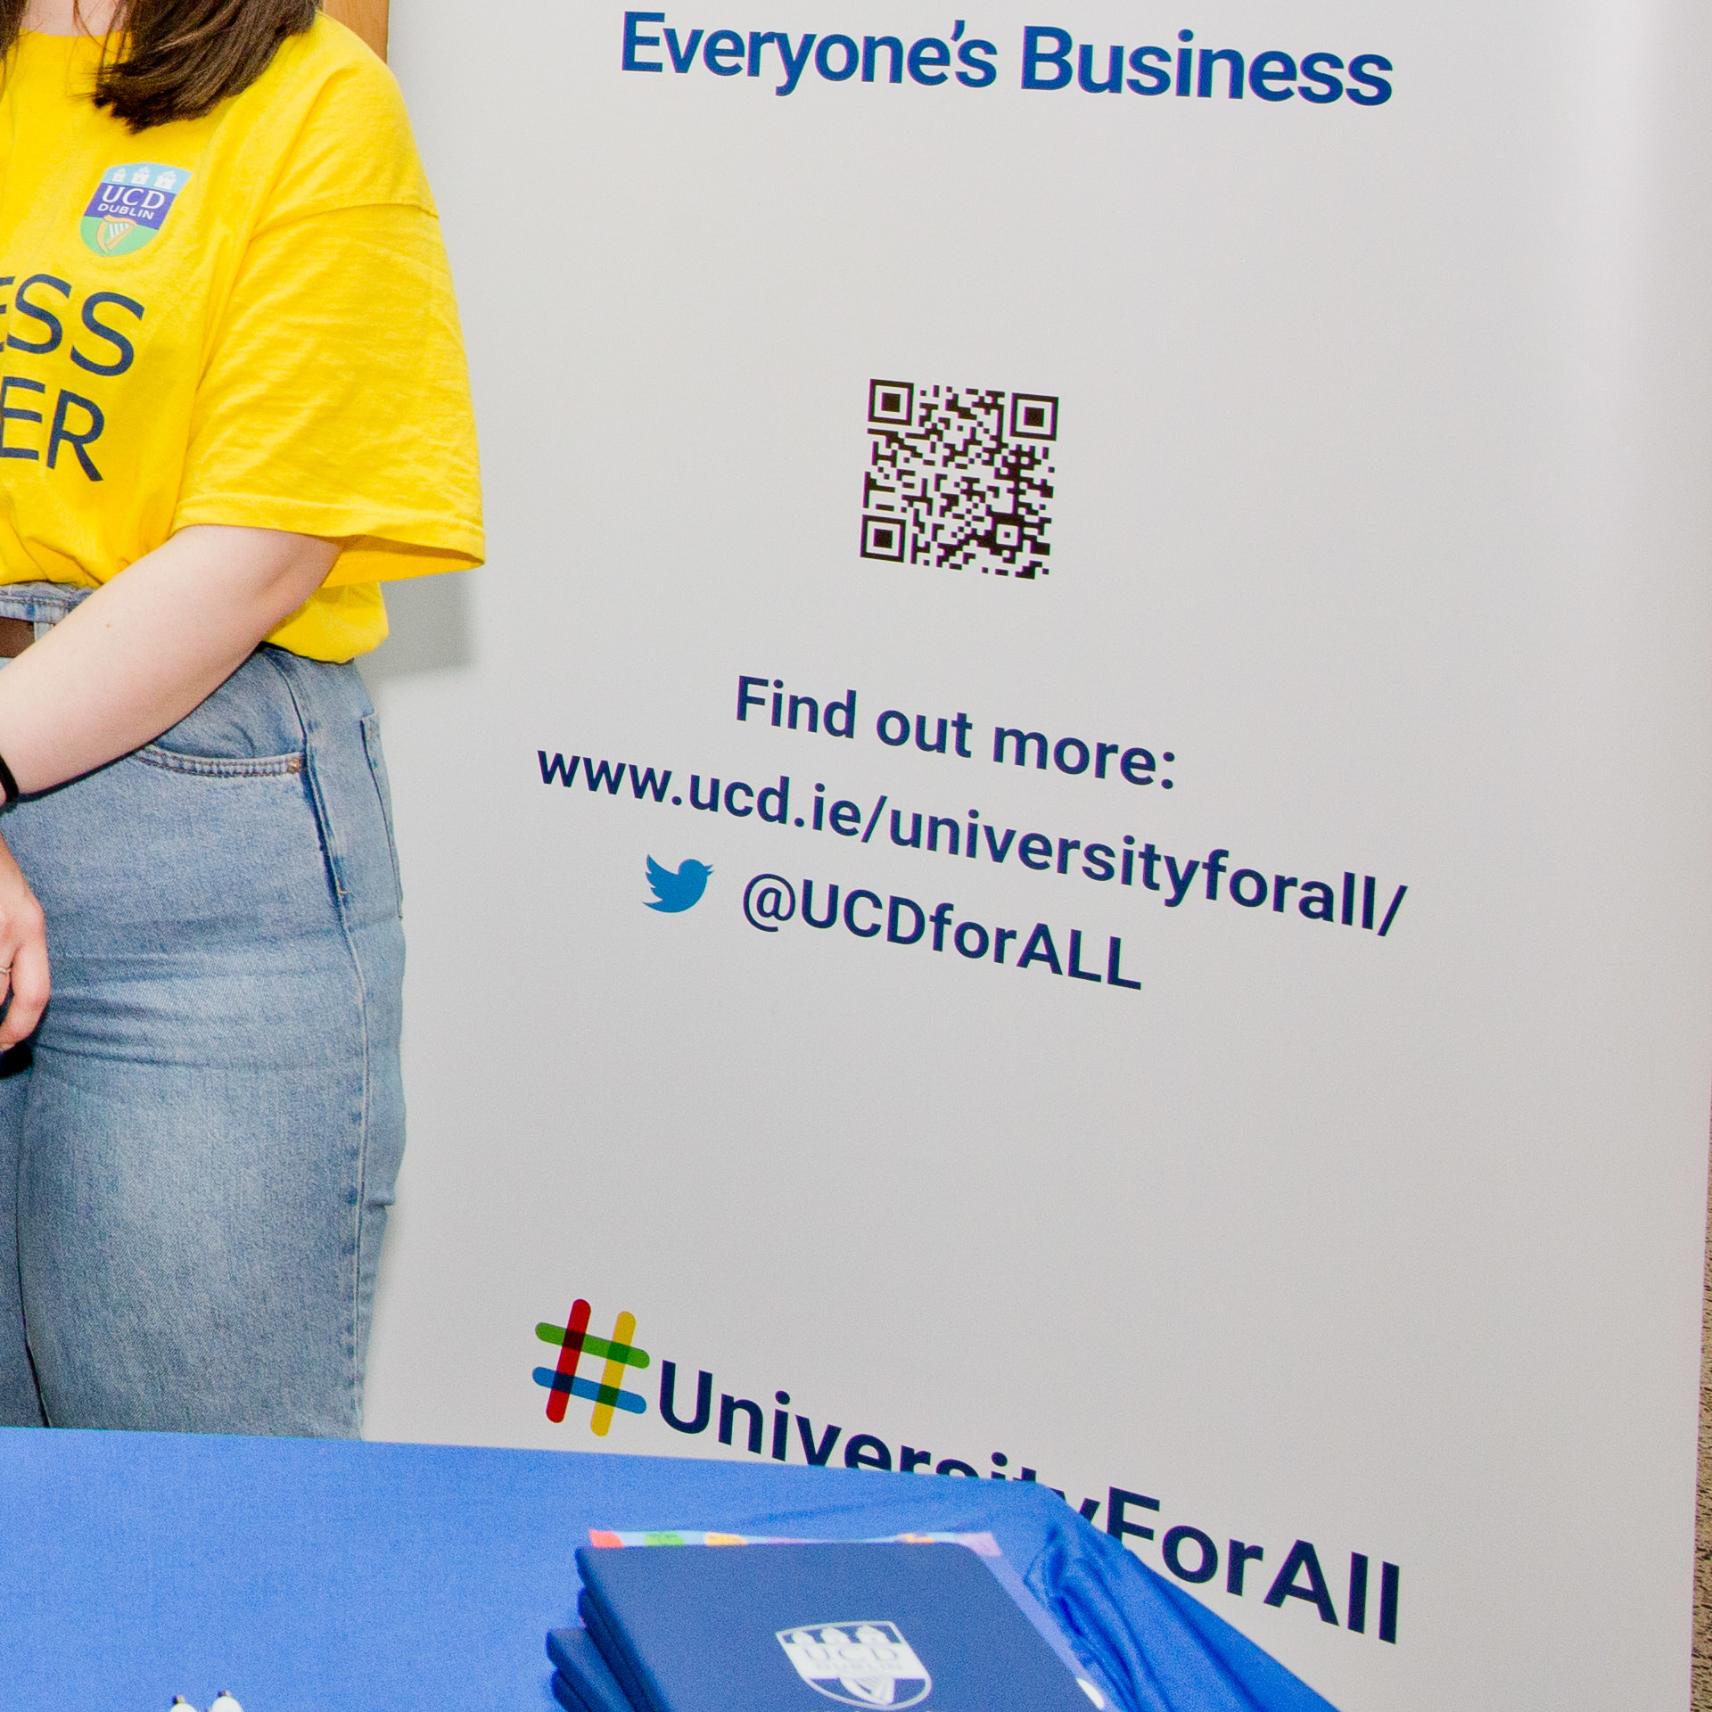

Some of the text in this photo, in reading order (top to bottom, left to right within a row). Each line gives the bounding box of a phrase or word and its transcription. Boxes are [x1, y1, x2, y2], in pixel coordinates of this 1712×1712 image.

[622, 11, 1392, 106] Everyone’s Business
[97, 202, 155, 221] DUBLIN
[101, 183, 168, 211] UCD
[737, 676, 1175, 789] Find out more:
[536, 746, 1408, 939] www.ucd.ie/universityforall/
[743, 871, 1145, 990] @UCDforALL
